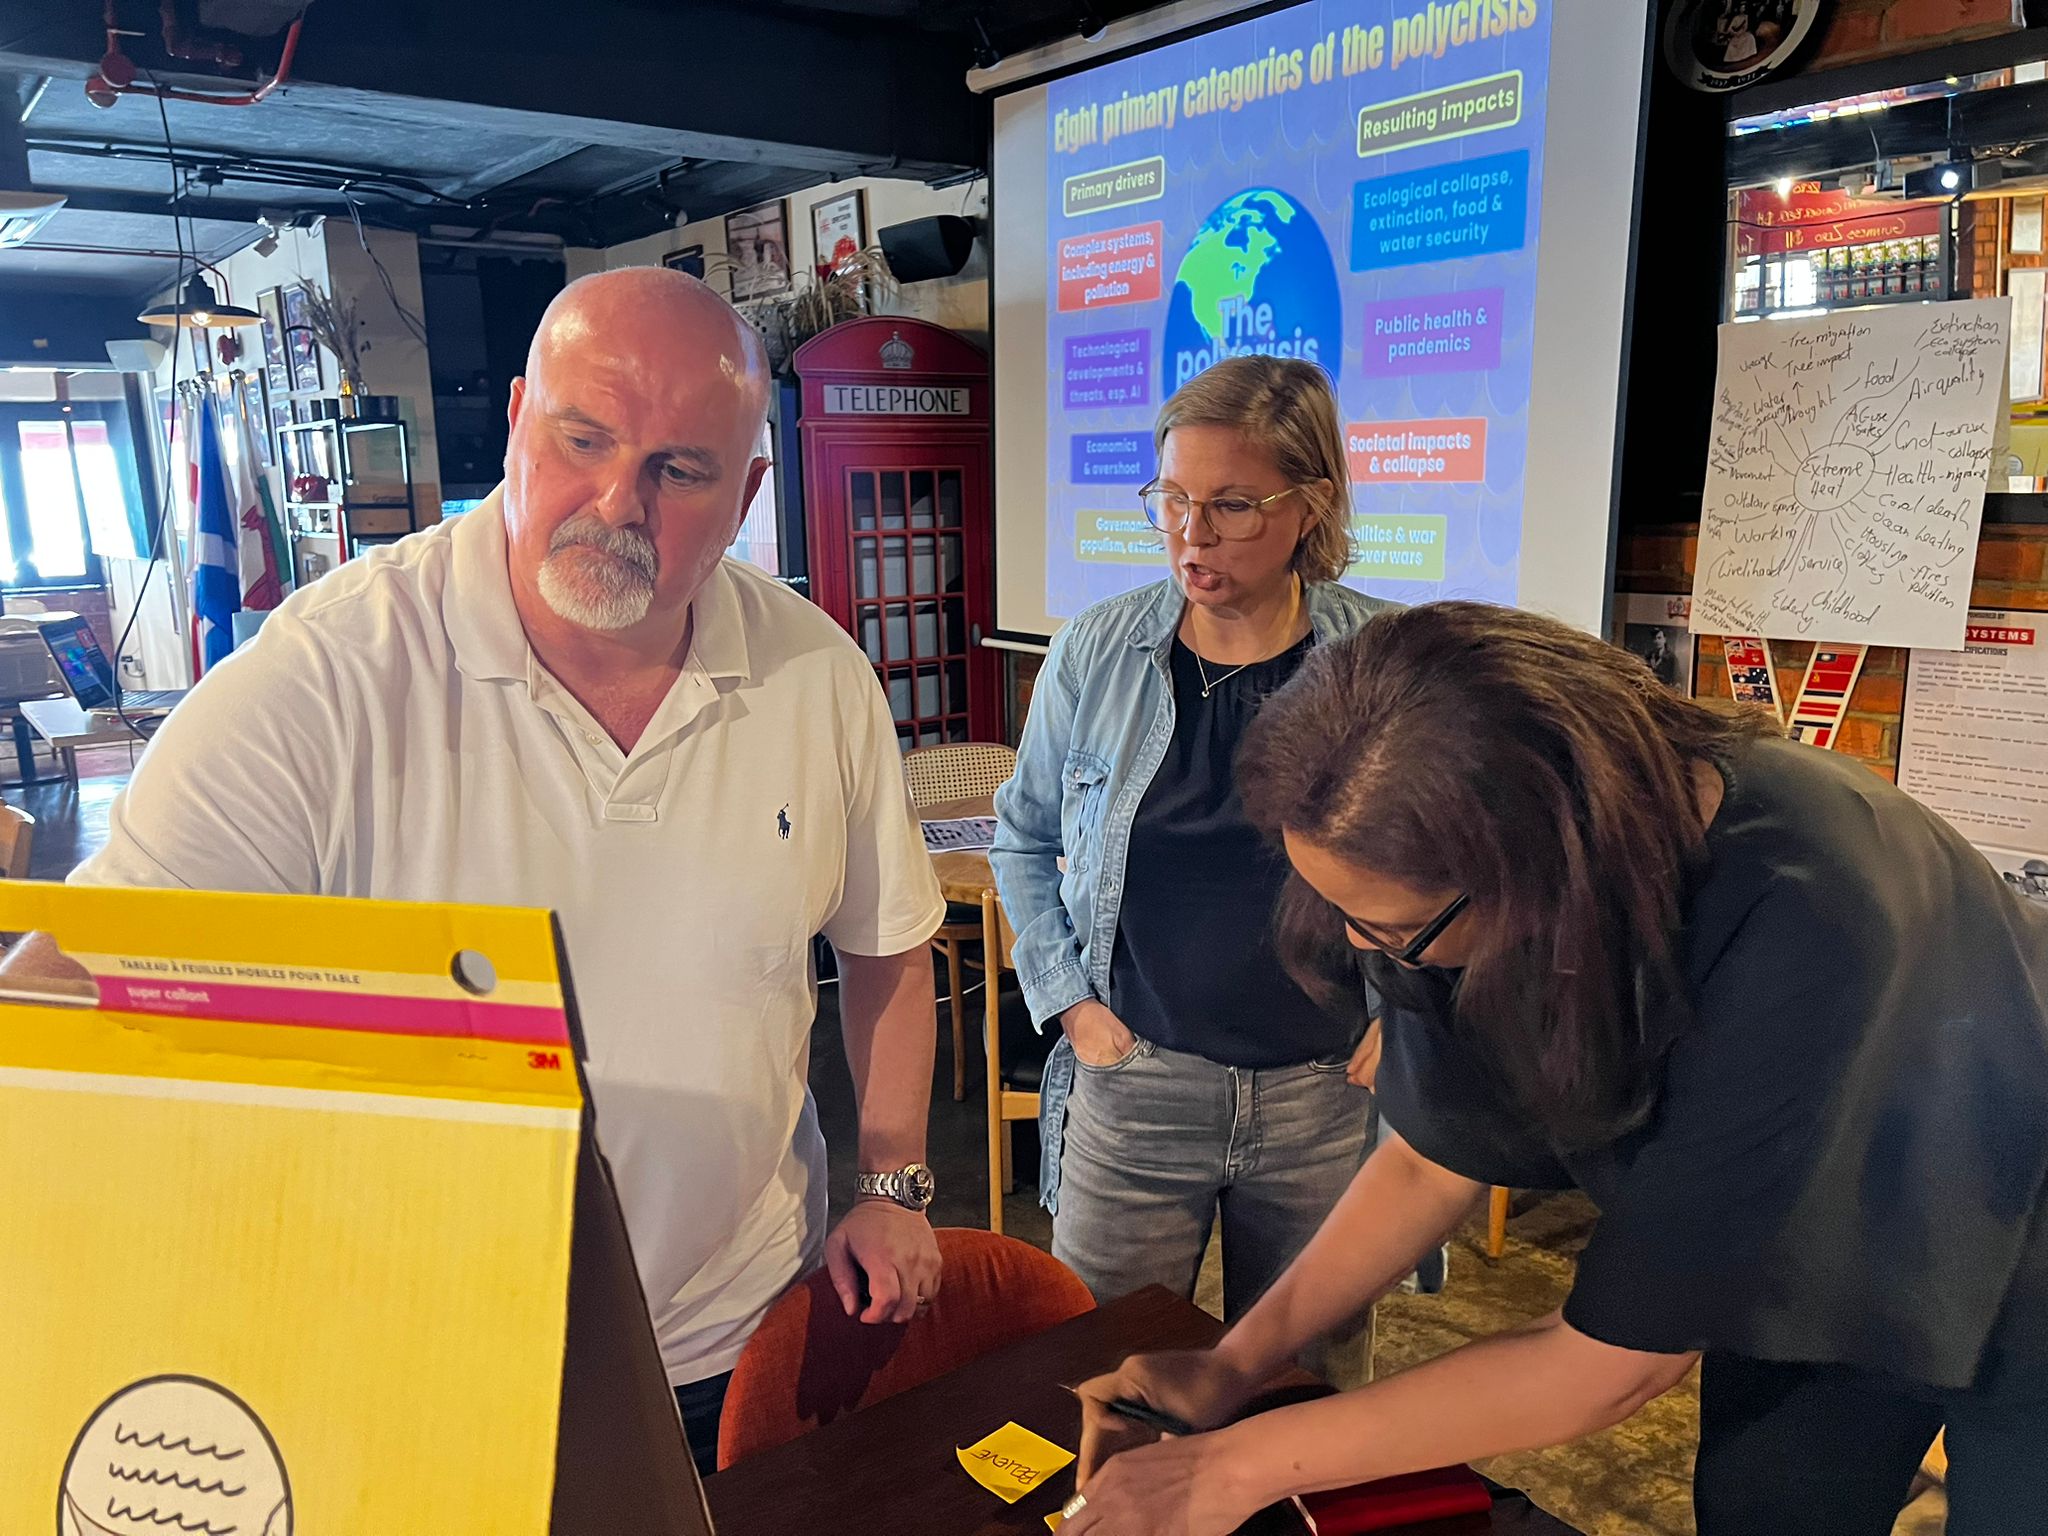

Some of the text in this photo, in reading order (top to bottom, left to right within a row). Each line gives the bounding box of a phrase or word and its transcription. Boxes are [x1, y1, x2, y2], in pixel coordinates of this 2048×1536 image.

[1055, 0, 1537, 153] Eight primary categories of the polycrisis
[1363, 90, 1514, 139] Resulting impacts
[1070, 169, 1156, 202] Primary drivers
[1364, 170, 1514, 209] Ecological collapse,
[1370, 194, 1502, 231] extinction, food &
[1063, 231, 1154, 260] Complex systems,
[1380, 222, 1489, 254] water security
[1062, 252, 1155, 281] including energy &
[1085, 281, 1129, 304] pollution
[1219, 295, 1273, 339] The
[1375, 307, 1487, 336] Public health &
[1072, 338, 1140, 359] Technological
[1388, 334, 1471, 363] pandemics
[1066, 361, 1144, 383] developments &
[834, 387, 962, 412] TELEPHONE
[1131, 385, 1141, 398] AI
[1086, 438, 1137, 453] Economics
[1349, 431, 1471, 456] Societal impacts
[1084, 461, 1140, 475] & overshoot
[1369, 456, 1445, 478] & collapse
[1801, 455, 1863, 481] Extreme
[1811, 480, 1844, 499] Heat
[1080, 537, 1126, 555] populism,
[1395, 526, 1405, 543] &
[1409, 530, 1437, 545] war
[1389, 551, 1424, 565] wars
[119, 959, 360, 985] TABLEAU À FEUILLES MOBILES POUR TABLE
[126, 986, 161, 1000] super
[528, 1051, 561, 1071] 3M
